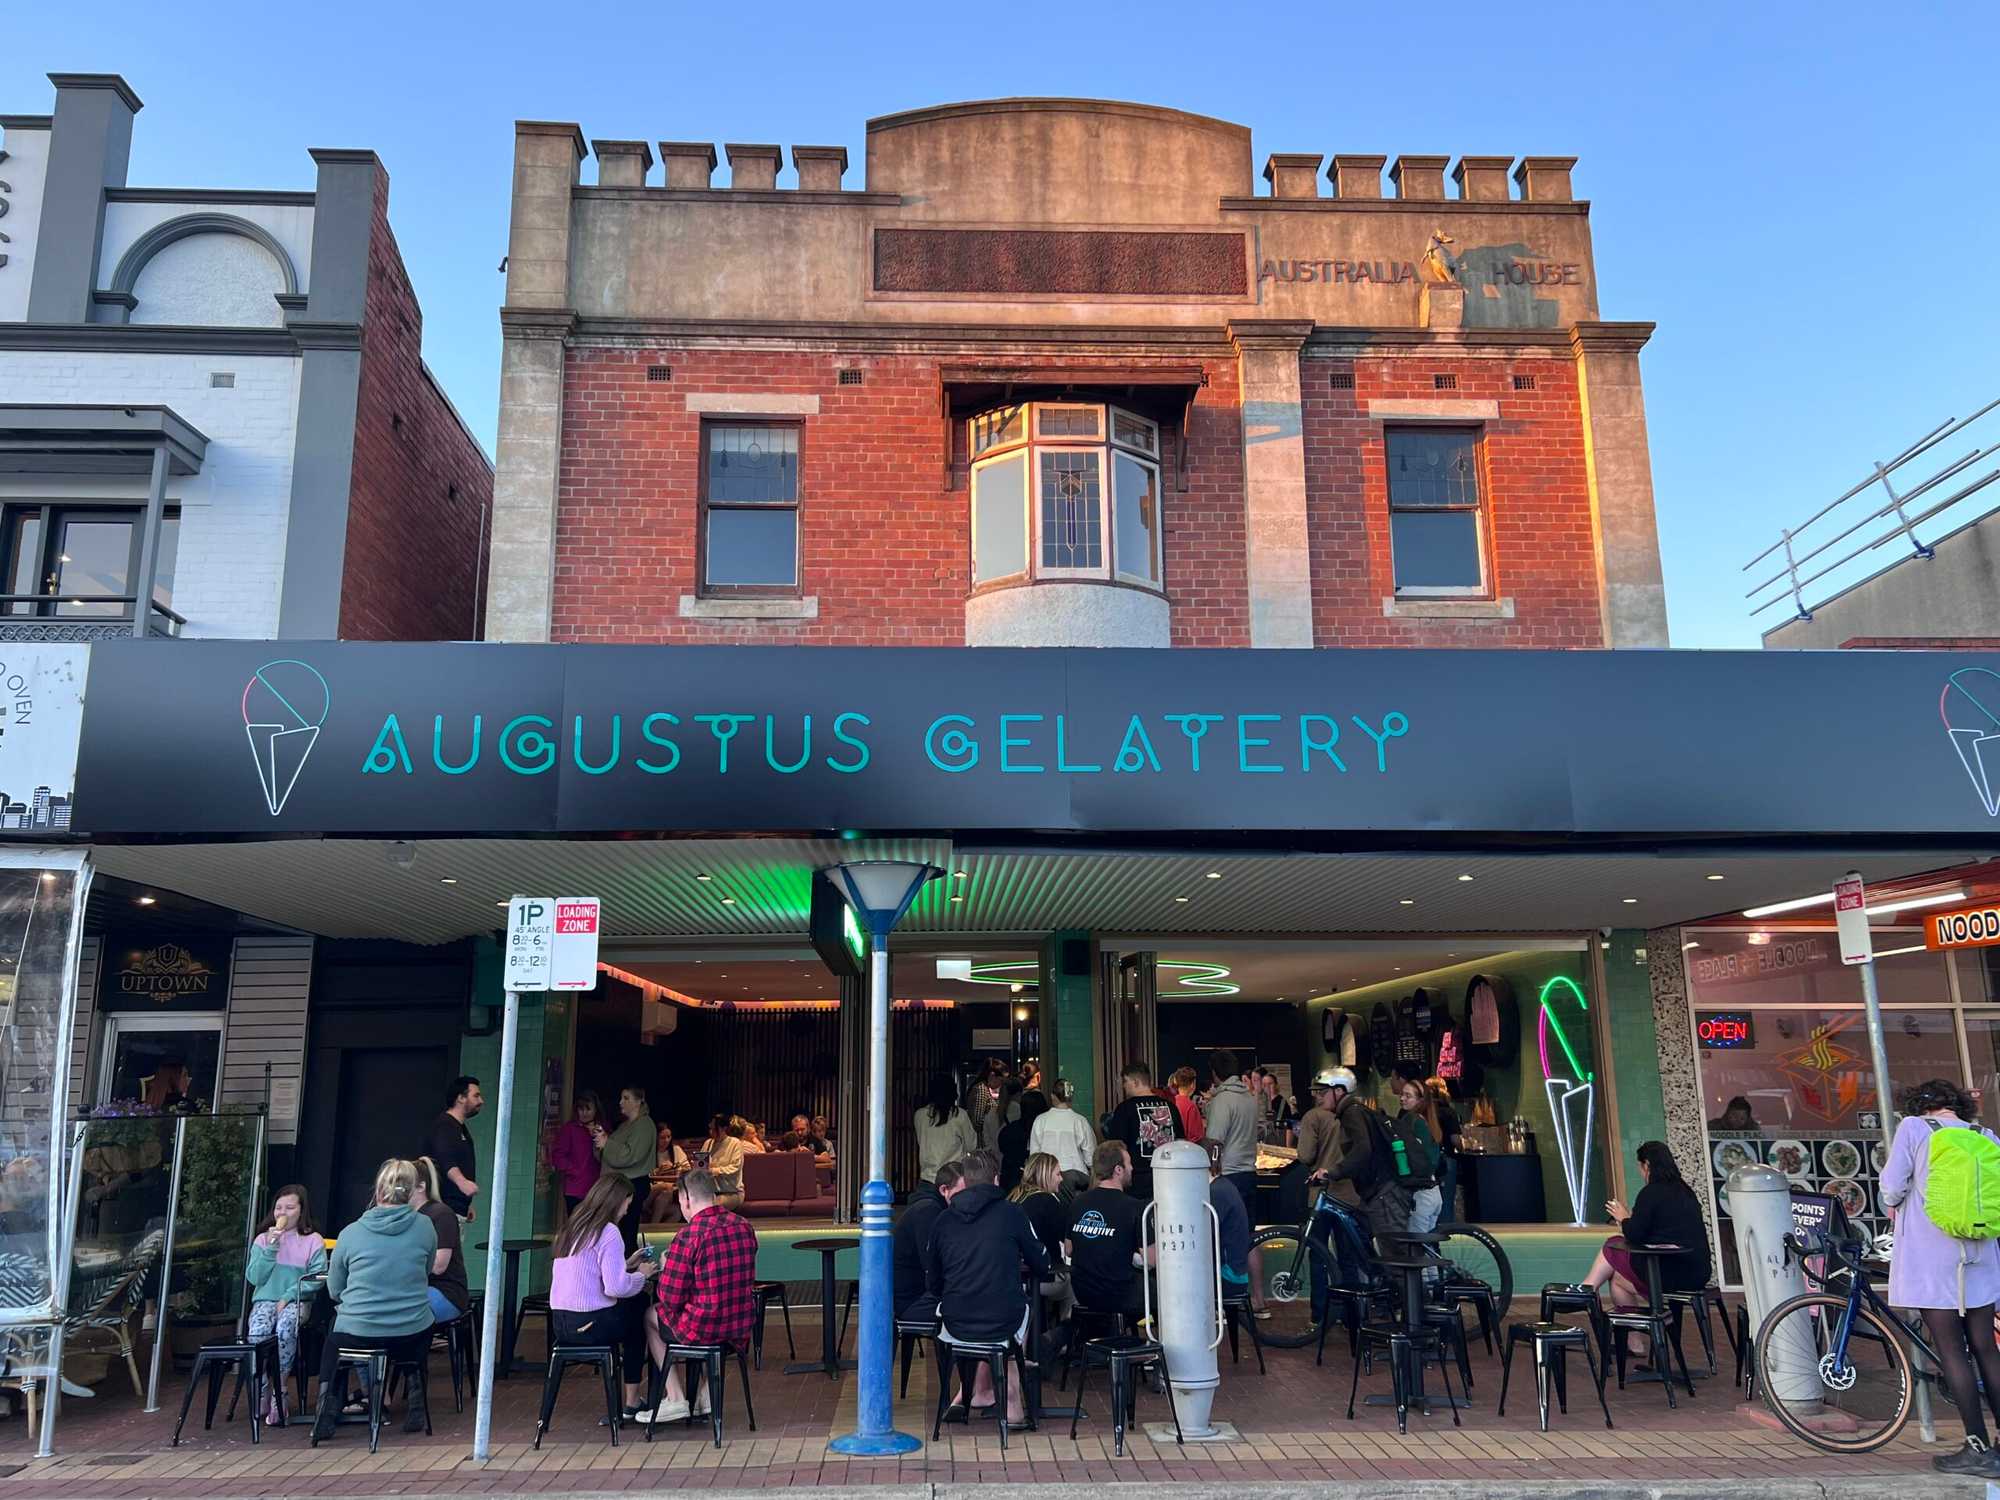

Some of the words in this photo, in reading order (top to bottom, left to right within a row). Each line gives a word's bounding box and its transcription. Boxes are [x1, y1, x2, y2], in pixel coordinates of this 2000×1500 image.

[1257, 260, 1422, 284] AUSTRALIA
[1490, 262, 1582, 286] HOUSE
[7, 675, 32, 725] OVEN
[361, 713, 871, 775] AUGUSTUS
[924, 711, 1409, 773] GELATERY
[519, 904, 544, 926] 1P
[558, 906, 596, 918] LOADING
[527, 926, 551, 934] ANGLE
[562, 919, 591, 931] ZONE
[121, 975, 209, 992] UPTOWN
[1699, 1022, 1747, 1039] OPEN
[1791, 1202, 1826, 1216] POINTS
[1072, 1224, 1116, 1236] AUTOMOTIVE
